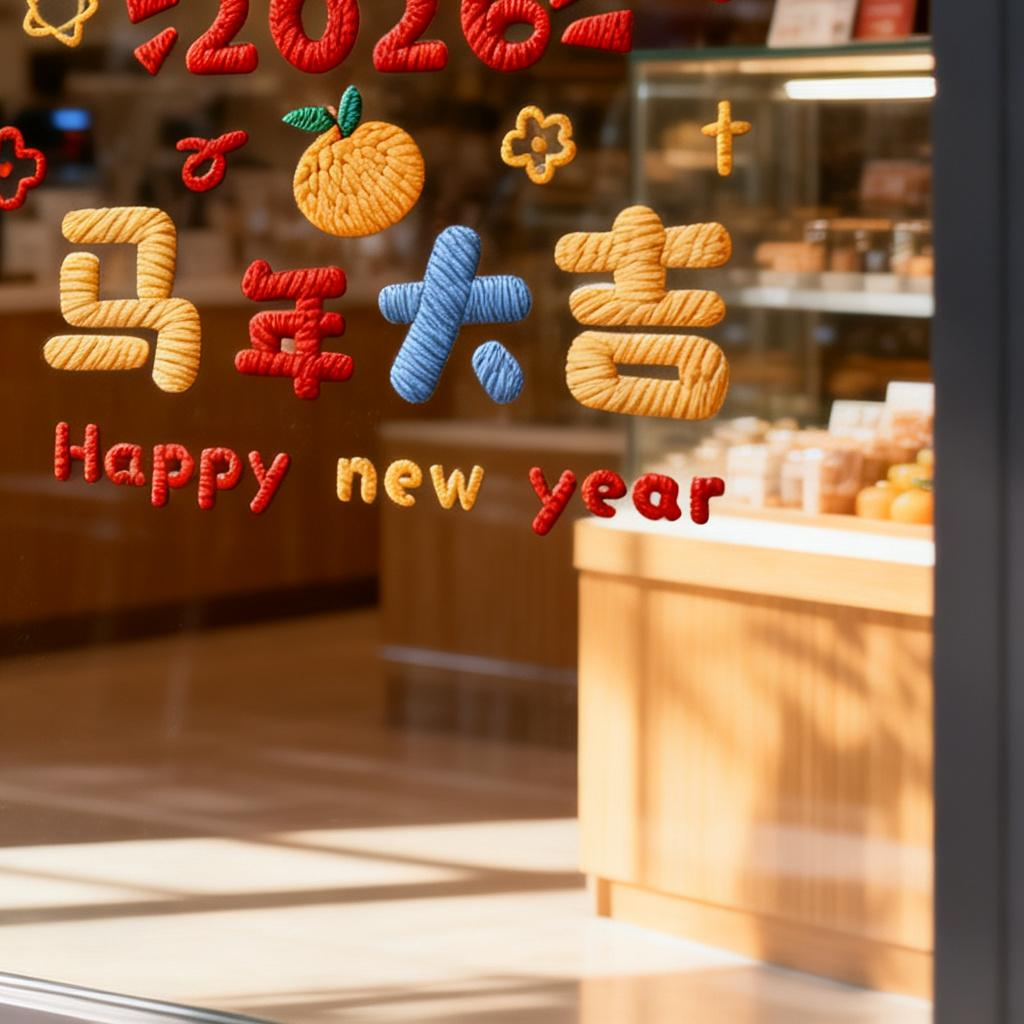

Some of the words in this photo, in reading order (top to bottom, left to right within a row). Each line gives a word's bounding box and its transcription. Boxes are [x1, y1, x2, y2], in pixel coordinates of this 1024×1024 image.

[53, 422, 291, 514] Happy
[336, 457, 484, 510] new
[529, 467, 725, 535] year
